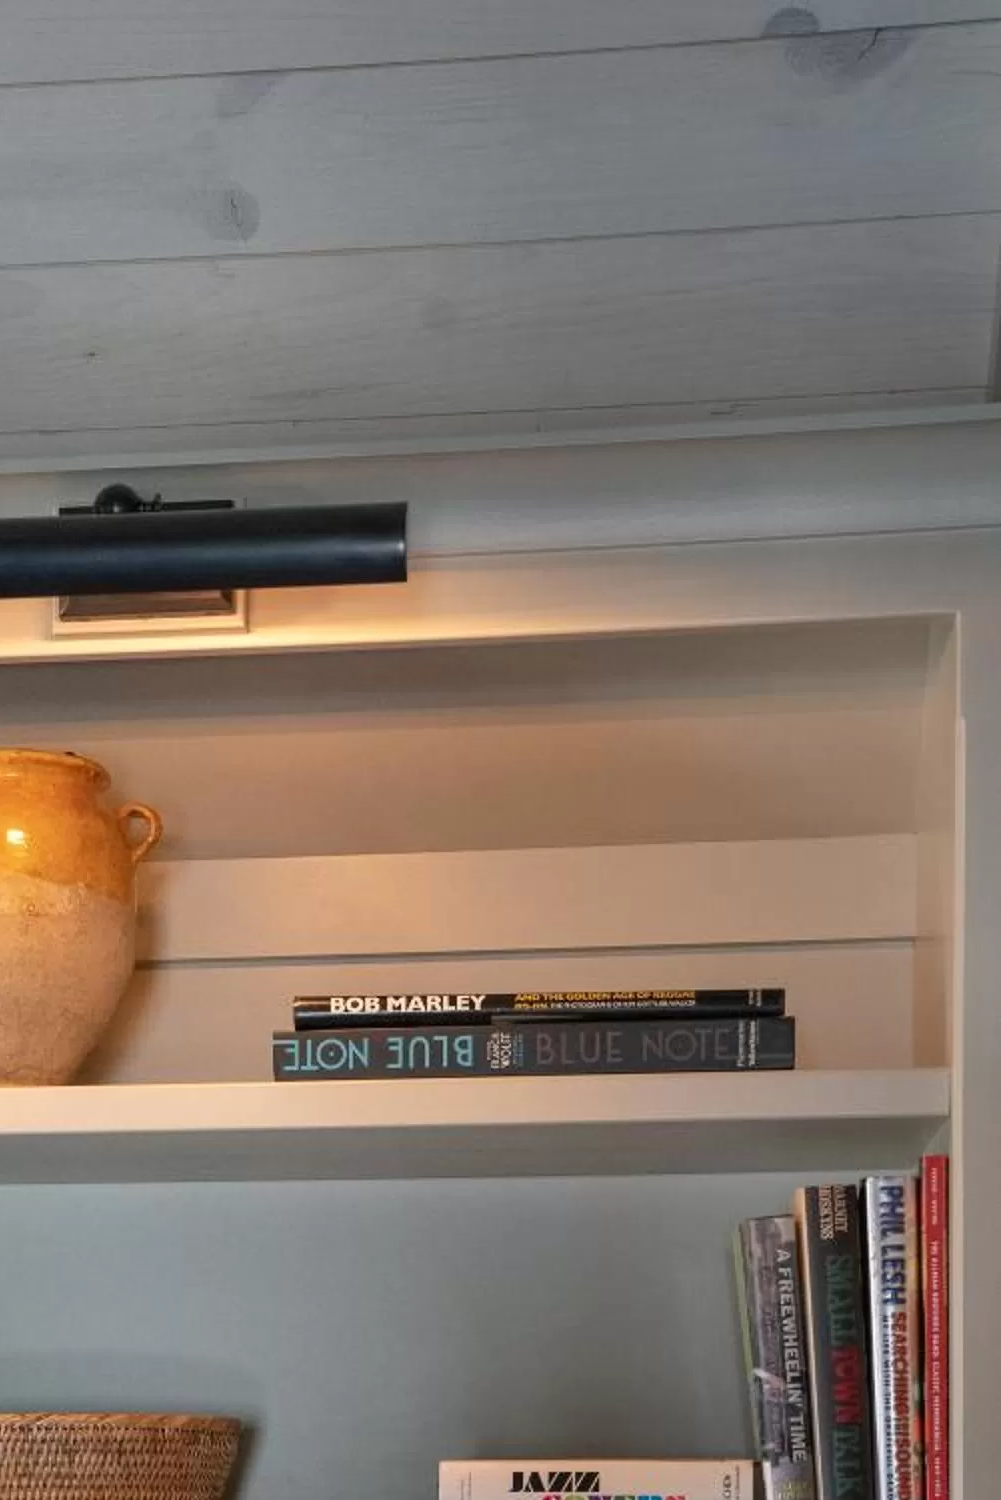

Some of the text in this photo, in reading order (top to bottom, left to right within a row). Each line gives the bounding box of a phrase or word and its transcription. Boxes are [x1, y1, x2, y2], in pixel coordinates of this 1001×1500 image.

[330, 995, 486, 1014] BOB MARLEY
[272, 1037, 370, 1071] NOTE
[386, 1034, 473, 1069] BLUE
[536, 1030, 624, 1065] BLUE
[642, 1027, 733, 1064] NOTE
[775, 1249, 792, 1263] A
[879, 1185, 907, 1305] PHIL LESH
[777, 1266, 804, 1407] FREEWHEELIN'
[826, 1255, 863, 1497] SMALL TOWN TALK
[891, 1312, 910, 1417] SEARCHING
[790, 1412, 808, 1463] TIME
[509, 1472, 600, 1493] JAZZ
[886, 1473, 895, 1500] DEAD
